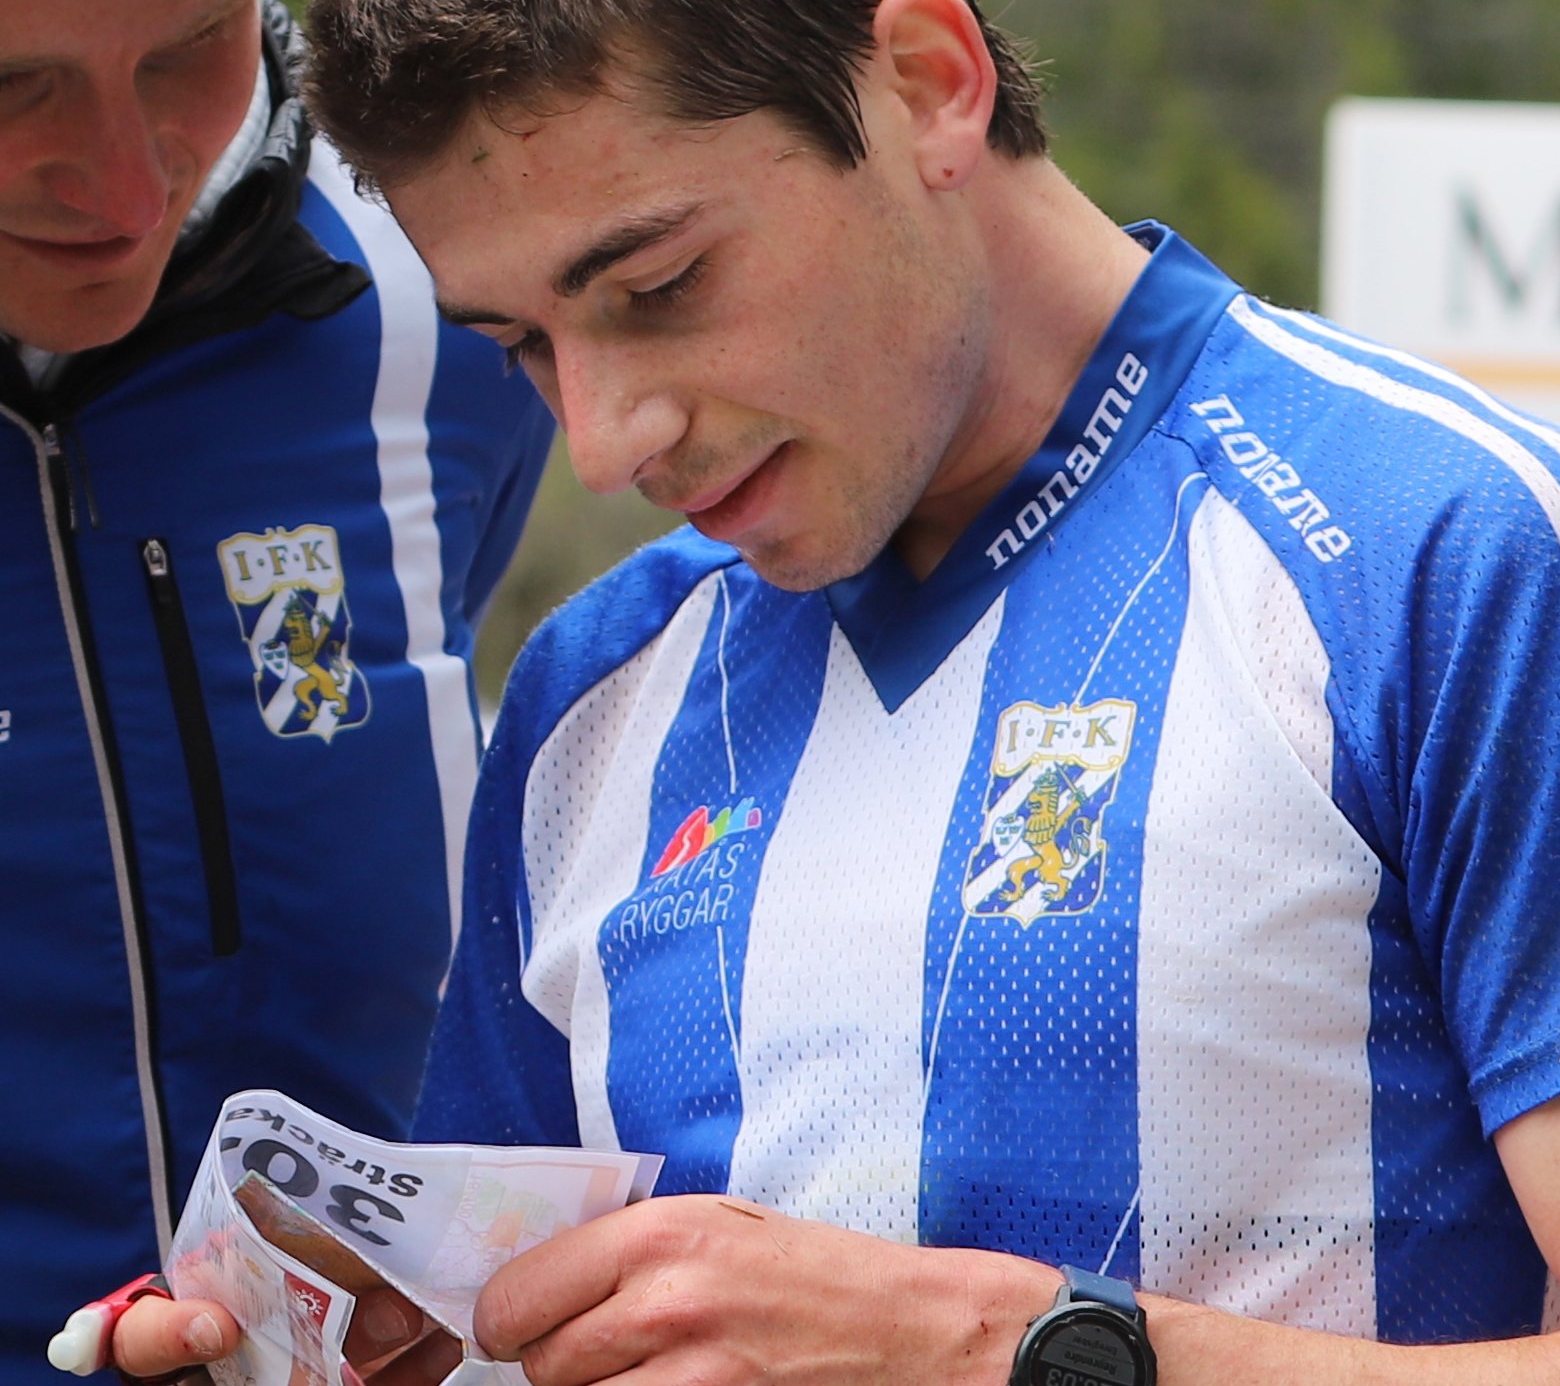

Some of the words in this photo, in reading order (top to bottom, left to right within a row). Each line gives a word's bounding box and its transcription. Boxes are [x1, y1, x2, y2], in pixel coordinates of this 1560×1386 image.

[984, 351, 1151, 571] noname
[1191, 392, 1351, 564] noname
[620, 884, 734, 943] RYGGAR
[220, 1136, 406, 1246] 30
[225, 1107, 425, 1198] Sträcka
